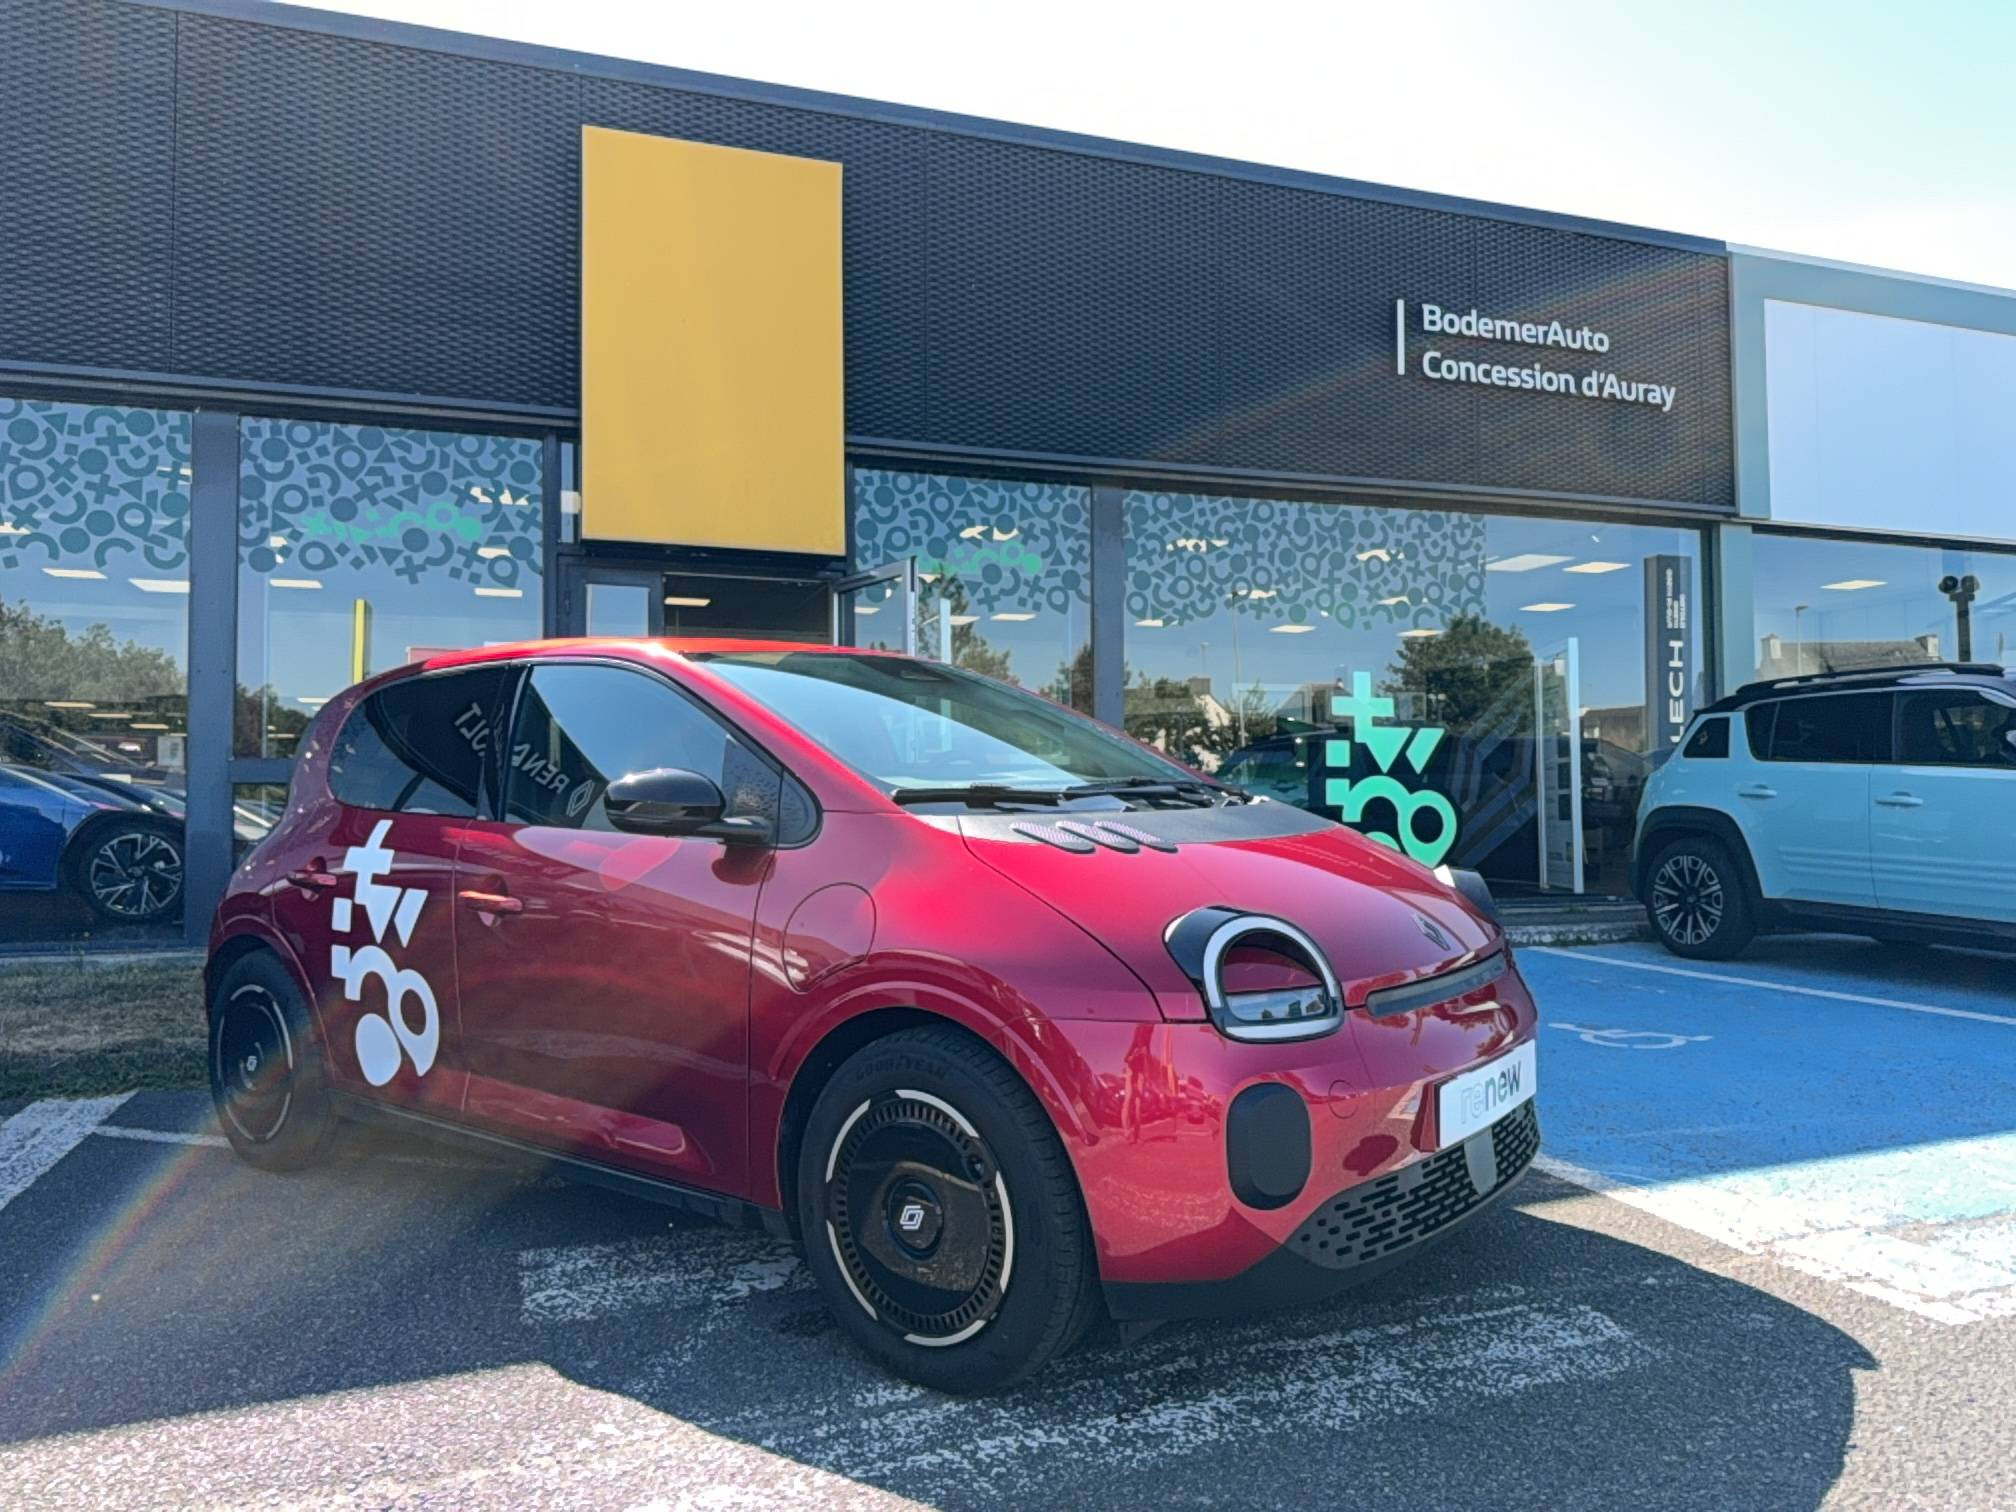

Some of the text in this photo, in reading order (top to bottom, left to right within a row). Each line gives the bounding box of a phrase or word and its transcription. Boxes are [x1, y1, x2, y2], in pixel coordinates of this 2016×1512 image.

[1422, 304, 1609, 353] BodemerAuto
[1422, 351, 1677, 412] Concession d'Auray
[1460, 1061, 1522, 1125] renew
